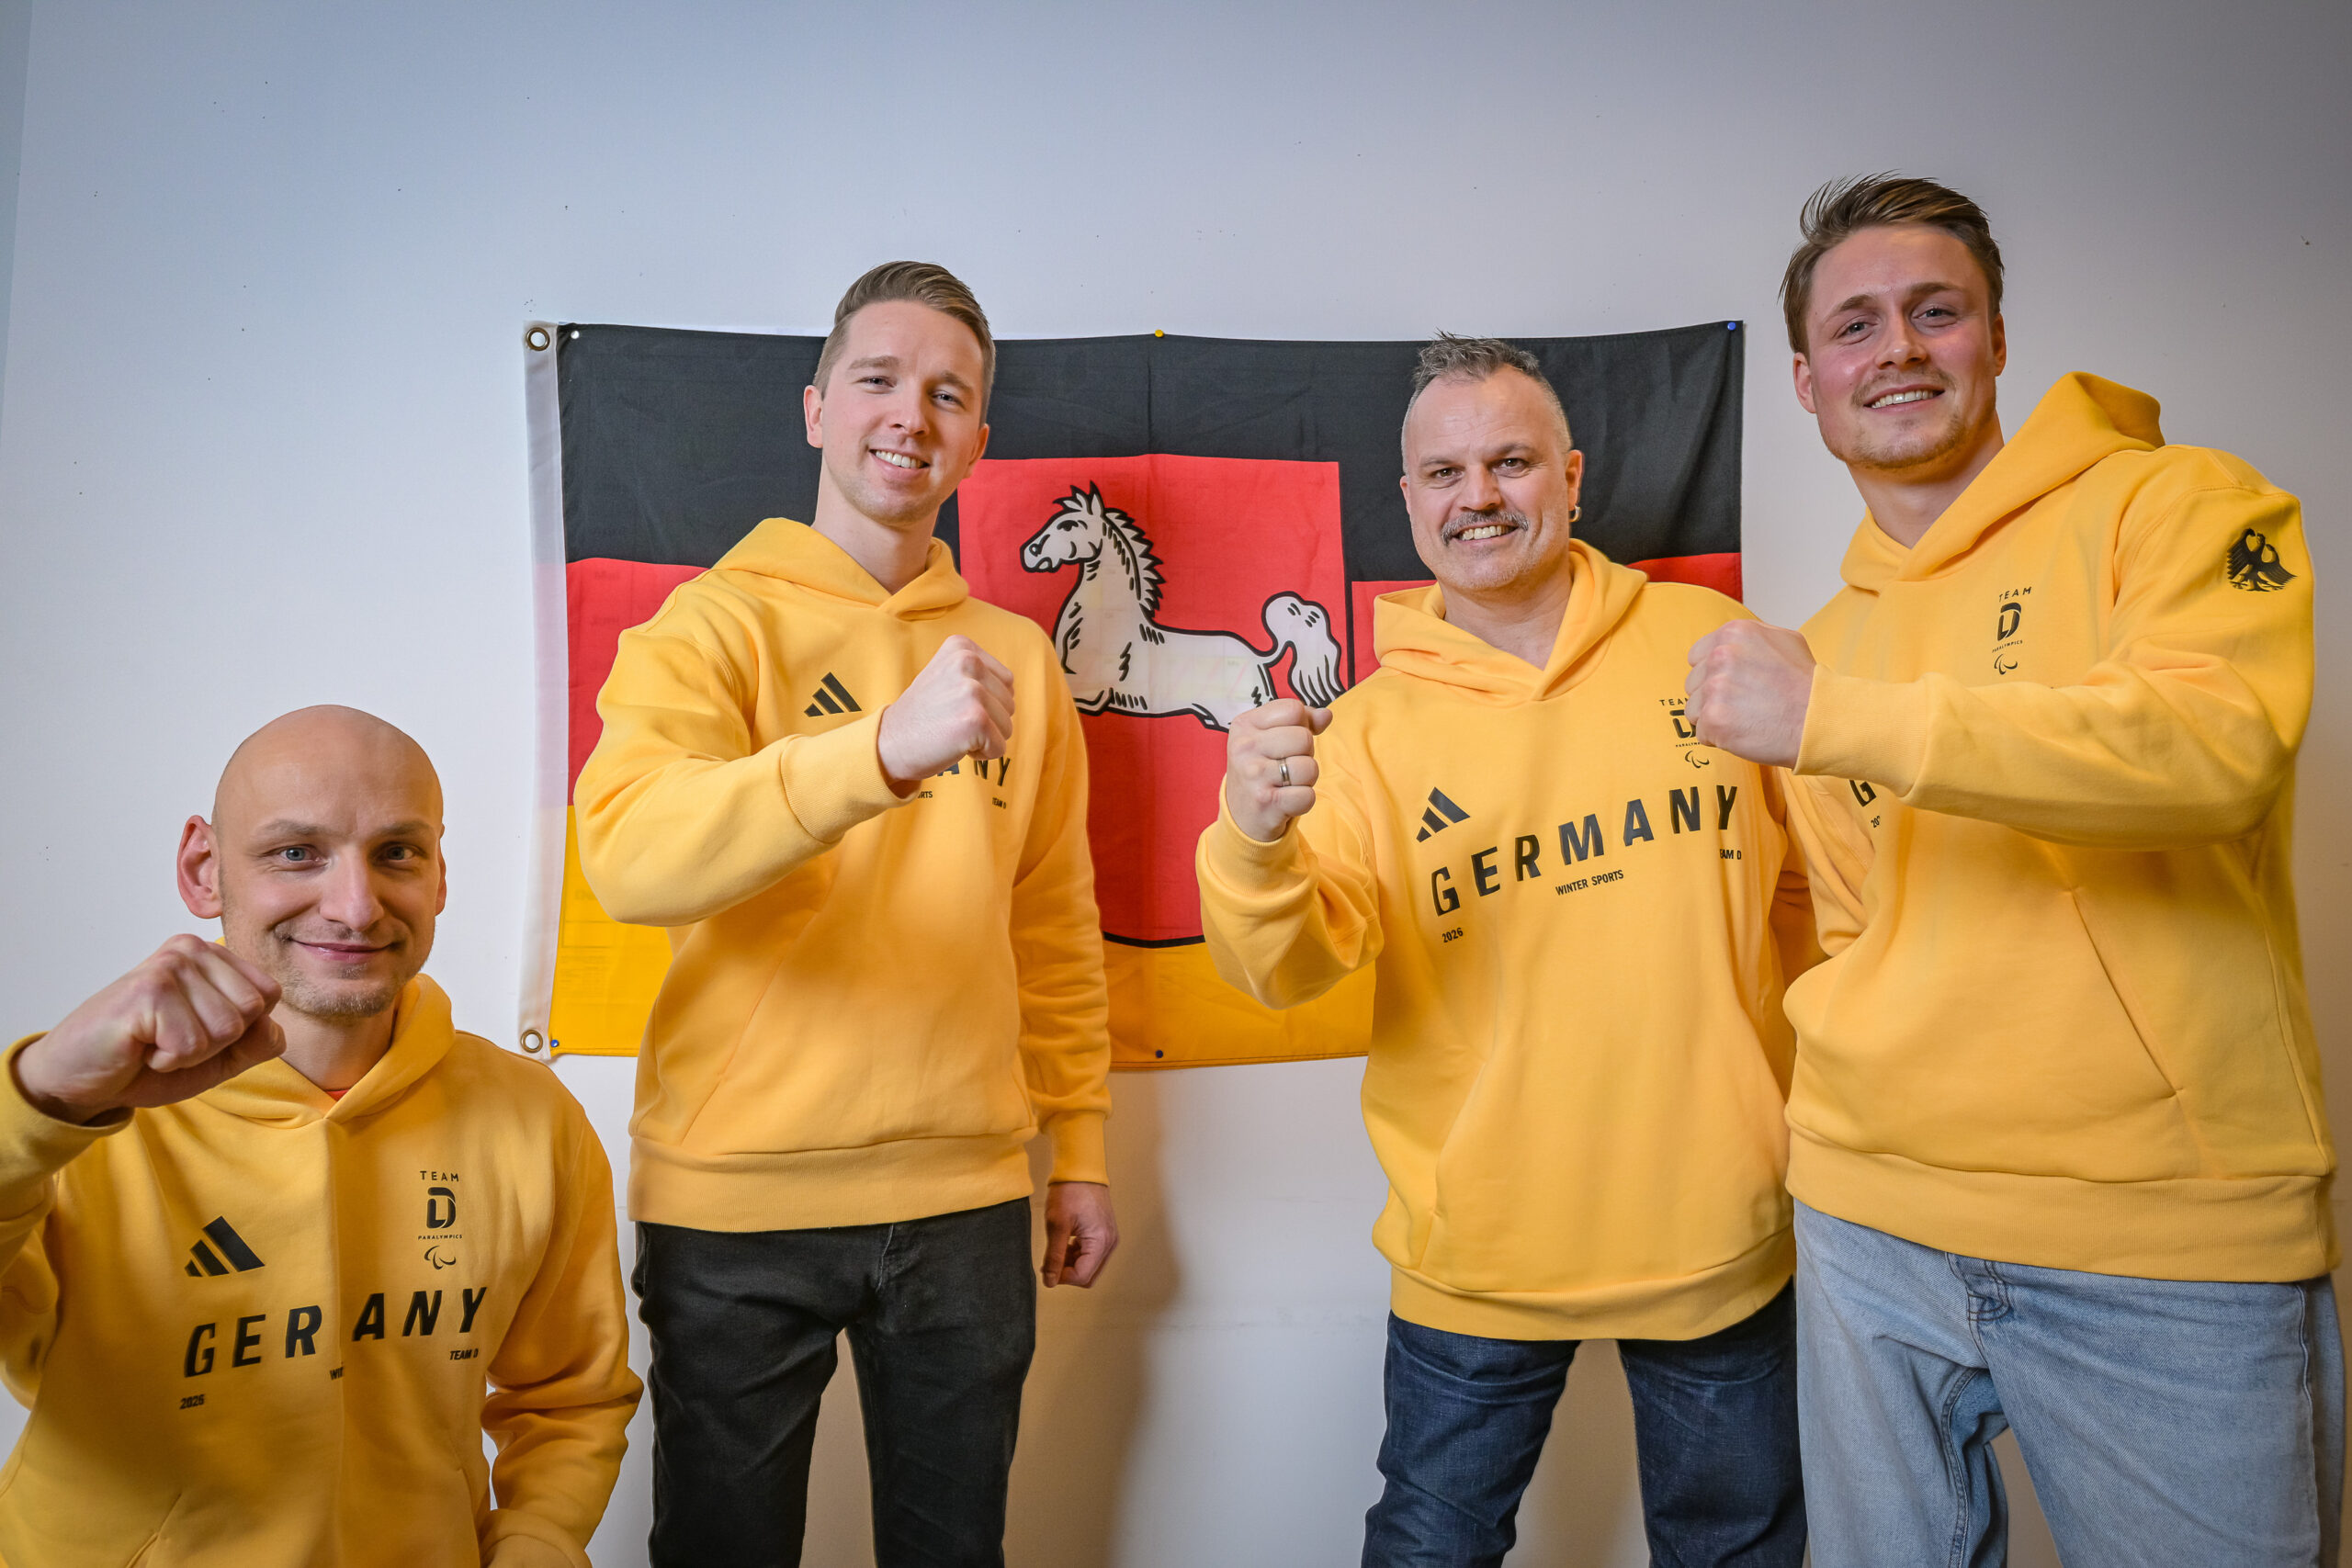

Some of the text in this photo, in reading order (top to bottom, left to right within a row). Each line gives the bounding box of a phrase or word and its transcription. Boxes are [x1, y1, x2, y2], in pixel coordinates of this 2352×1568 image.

[1999, 586, 2031, 603] TEAM
[1997, 603, 2021, 641] D
[992, 797, 1002, 807] TEAM
[1430, 784, 1737, 917] GERMANY
[1736, 851, 1741, 860] D
[1555, 869, 1623, 896] WINTER SPORTS
[1442, 927, 1464, 943] 2026
[420, 1170, 459, 1182] TEAM
[426, 1187, 456, 1229] D
[184, 1287, 487, 1378] GERANY
[449, 1349, 472, 1360] TEAM
[180, 1393, 205, 1410] 2026
